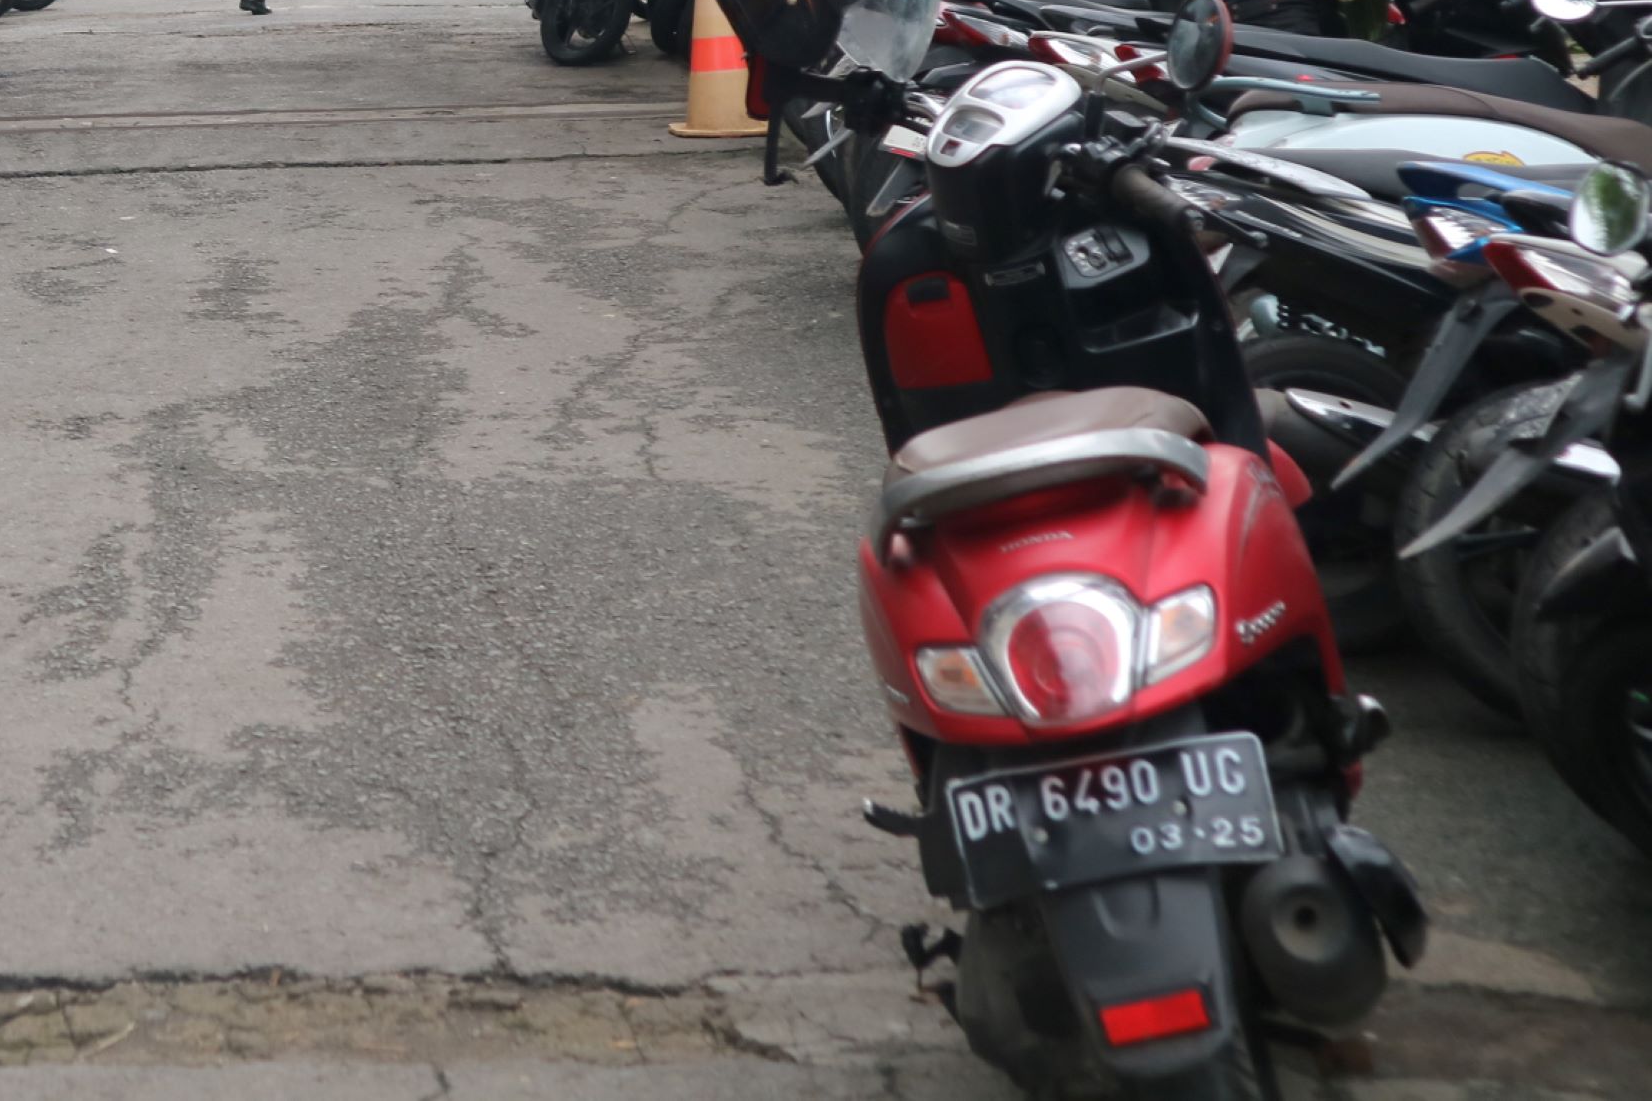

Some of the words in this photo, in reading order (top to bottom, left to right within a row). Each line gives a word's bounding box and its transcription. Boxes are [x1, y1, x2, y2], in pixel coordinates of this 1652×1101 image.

[958, 783, 1017, 842] DR
[1041, 759, 1161, 821] 6490
[1180, 747, 1246, 798] UG
